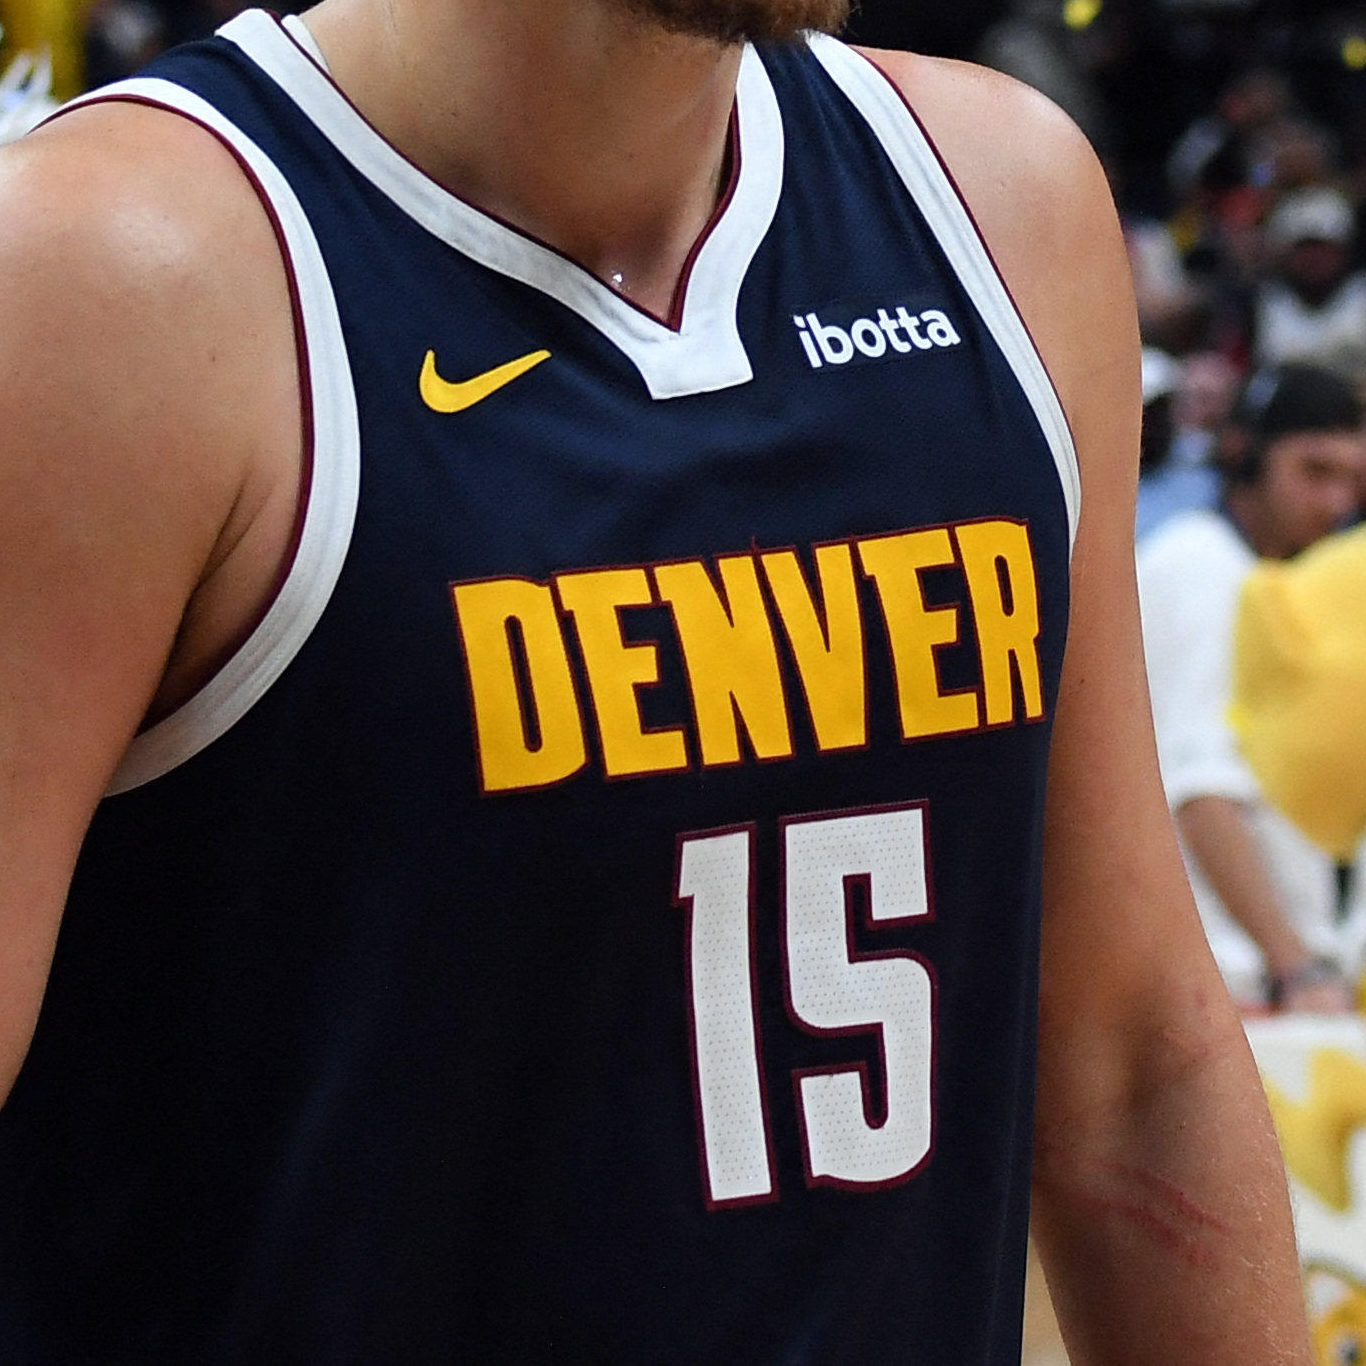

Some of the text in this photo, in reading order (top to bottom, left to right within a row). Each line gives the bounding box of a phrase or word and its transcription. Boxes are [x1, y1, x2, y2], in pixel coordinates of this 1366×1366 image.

[793, 306, 961, 368] ibotta
[448, 516, 1045, 796] DENVER
[671, 799, 938, 1211] 15
